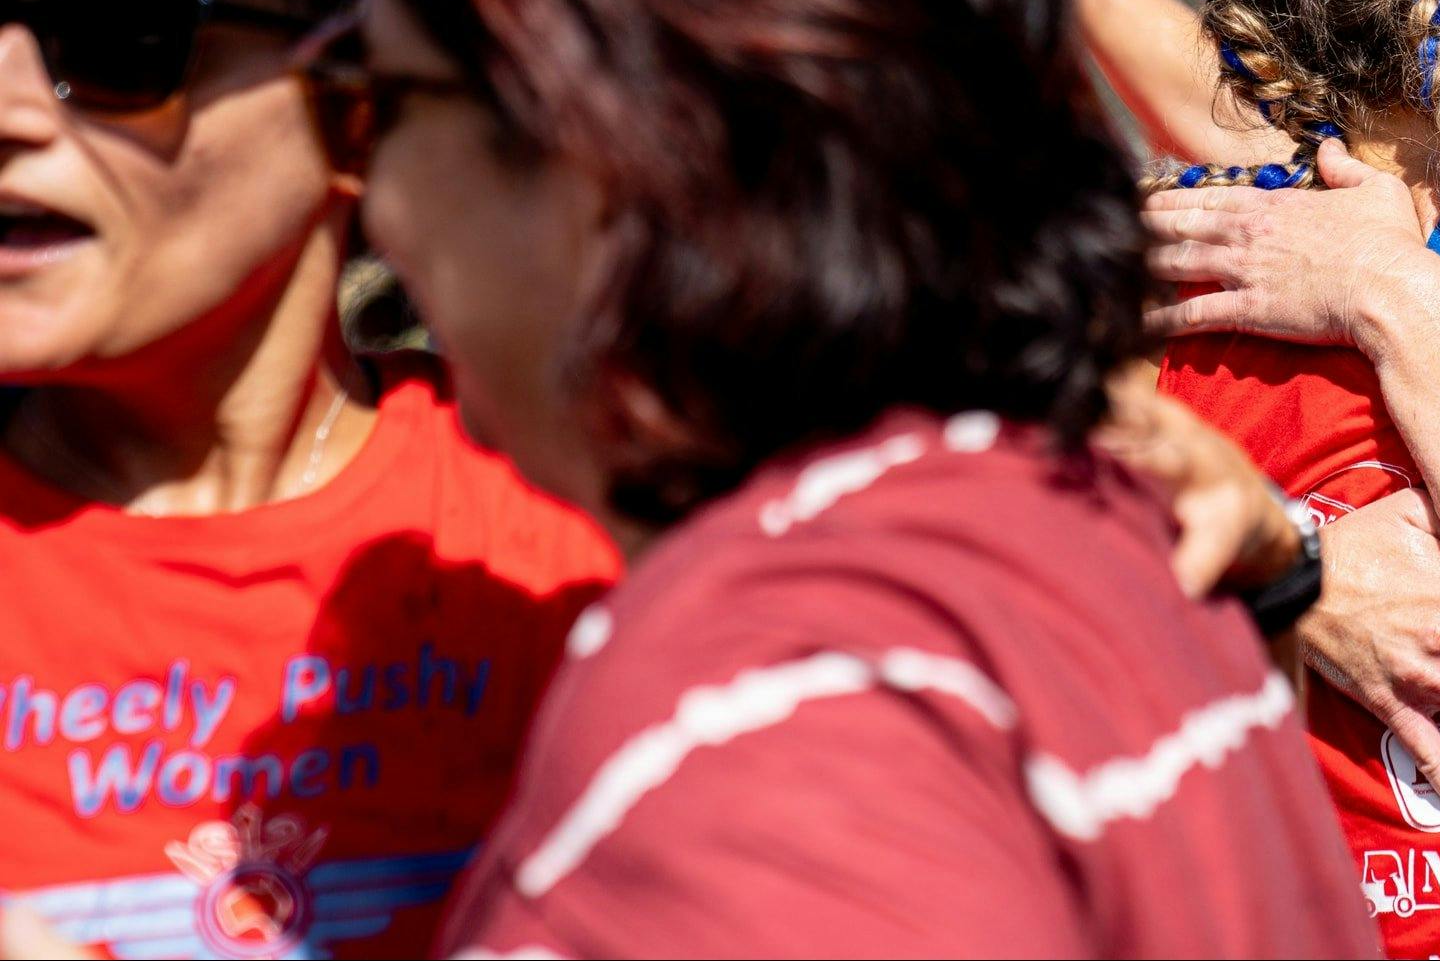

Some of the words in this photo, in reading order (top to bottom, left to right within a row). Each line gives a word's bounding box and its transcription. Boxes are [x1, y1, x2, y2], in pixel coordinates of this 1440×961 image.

[0, 658, 235, 749] heely
[281, 643, 491, 725] Pushy
[66, 741, 380, 818] Women
